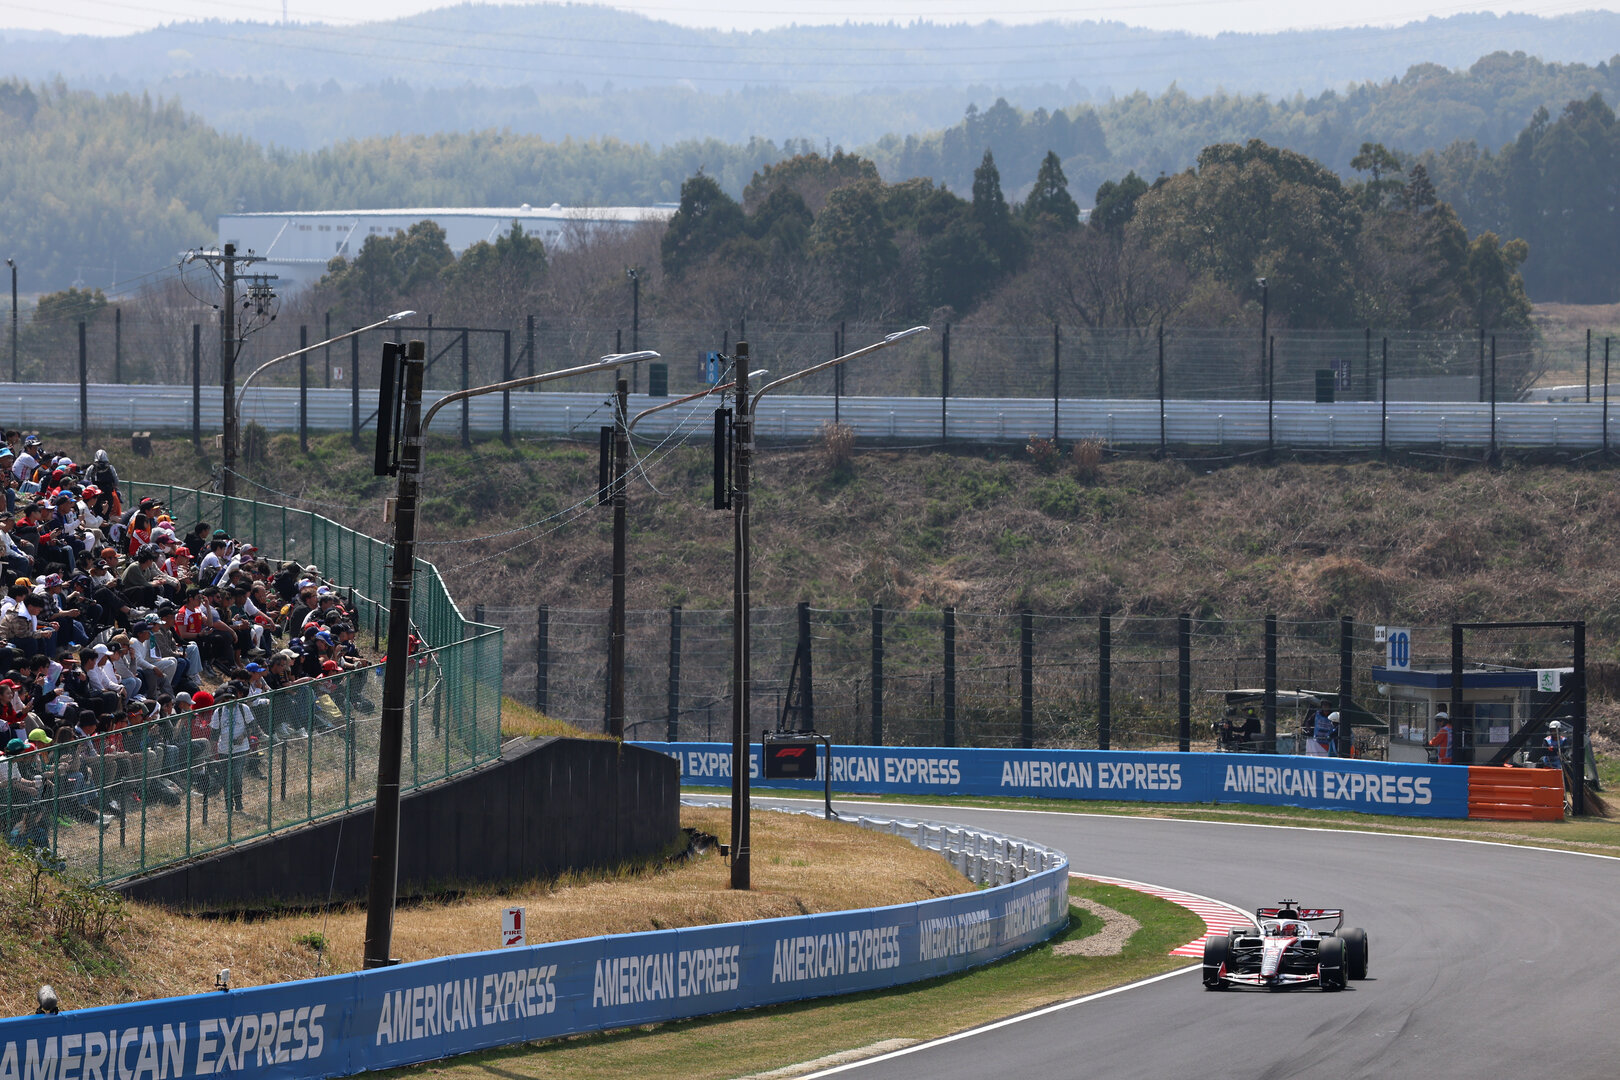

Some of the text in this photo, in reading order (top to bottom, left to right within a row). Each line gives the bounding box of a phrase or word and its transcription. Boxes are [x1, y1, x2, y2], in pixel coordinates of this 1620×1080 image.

[1389, 632, 1408, 667] 10
[688, 752, 758, 778] EXPRS
[884, 757, 961, 785] EXPRESS
[1000, 760, 1182, 790] AMERICAN EXPRESS
[1224, 765, 1433, 805] AMERICAN EXPRESS
[772, 926, 900, 984] AMERICAN EXPRESS
[593, 945, 740, 1008] AMERICAN EXPRESS
[376, 964, 558, 1046] AMERICAN EXPRESS
[0, 1004, 326, 1080] AMERICAN EXPRESS
